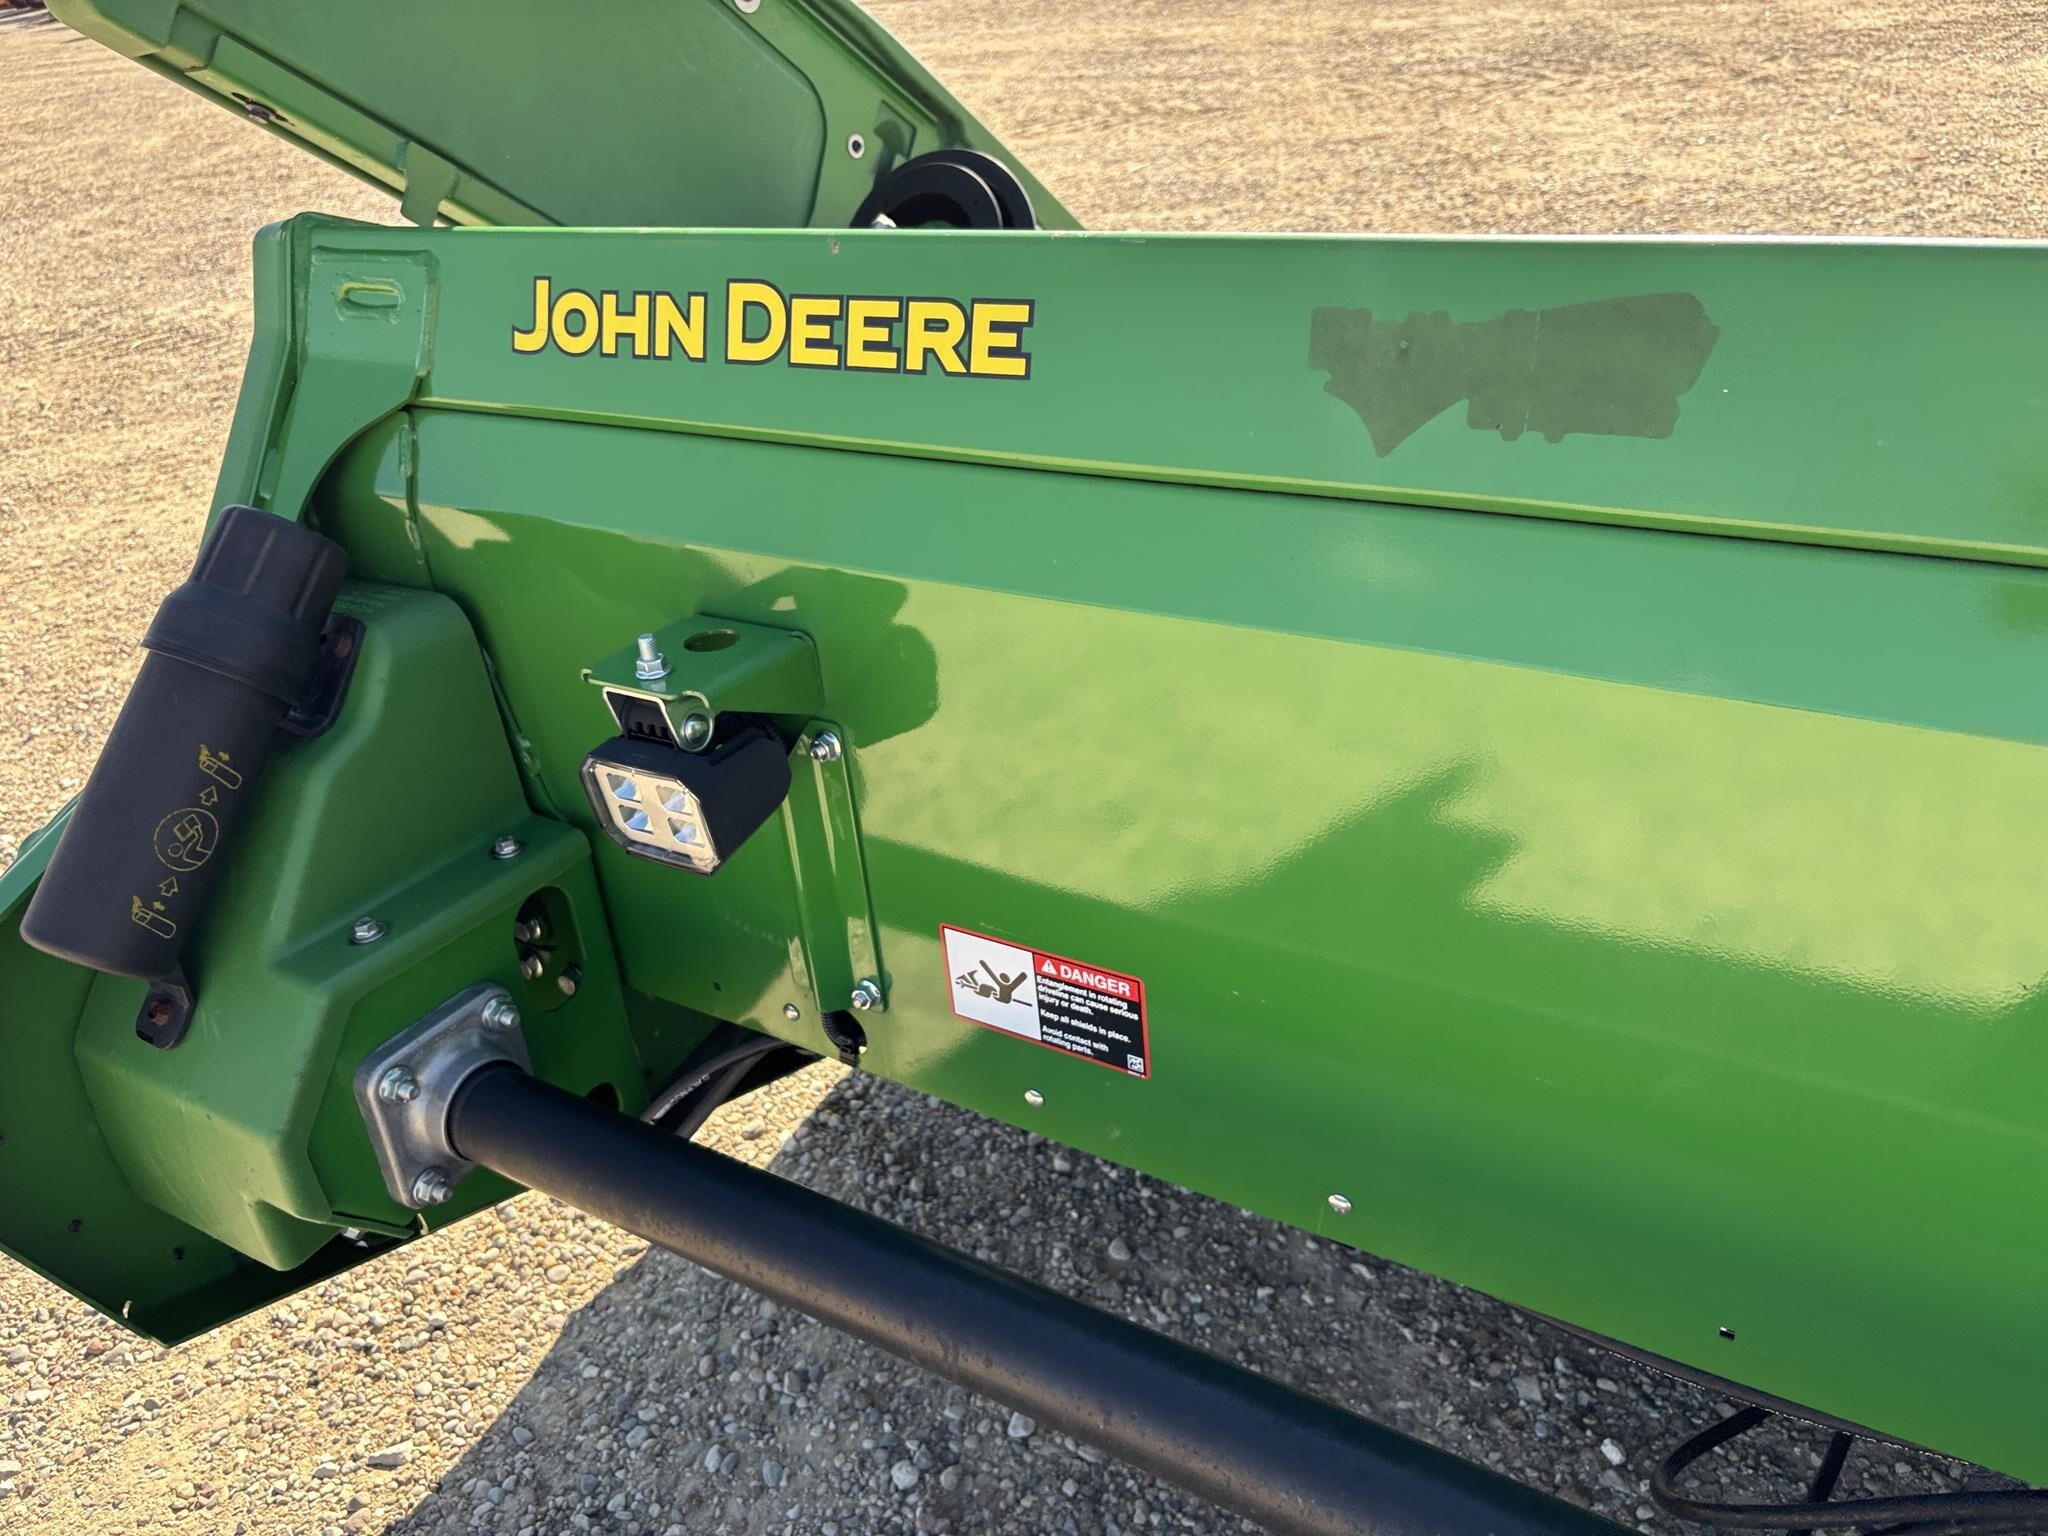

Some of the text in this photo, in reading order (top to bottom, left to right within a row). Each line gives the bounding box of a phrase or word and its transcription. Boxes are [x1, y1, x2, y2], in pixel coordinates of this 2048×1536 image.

[512, 276, 1035, 380] JOHN DEERE
[1037, 975, 1128, 1010] Entanglement in rotating
[1060, 965, 1130, 996] DANGER
[1038, 984, 1139, 1021] driveline can cause serious
[1039, 993, 1059, 1006] injury
[1070, 1002, 1094, 1015] death.
[1040, 1009, 1131, 1043] Keep all shields in place.
[1042, 1025, 1109, 1052] Avoid contact with
[1043, 1034, 1094, 1055] rotating parts.
